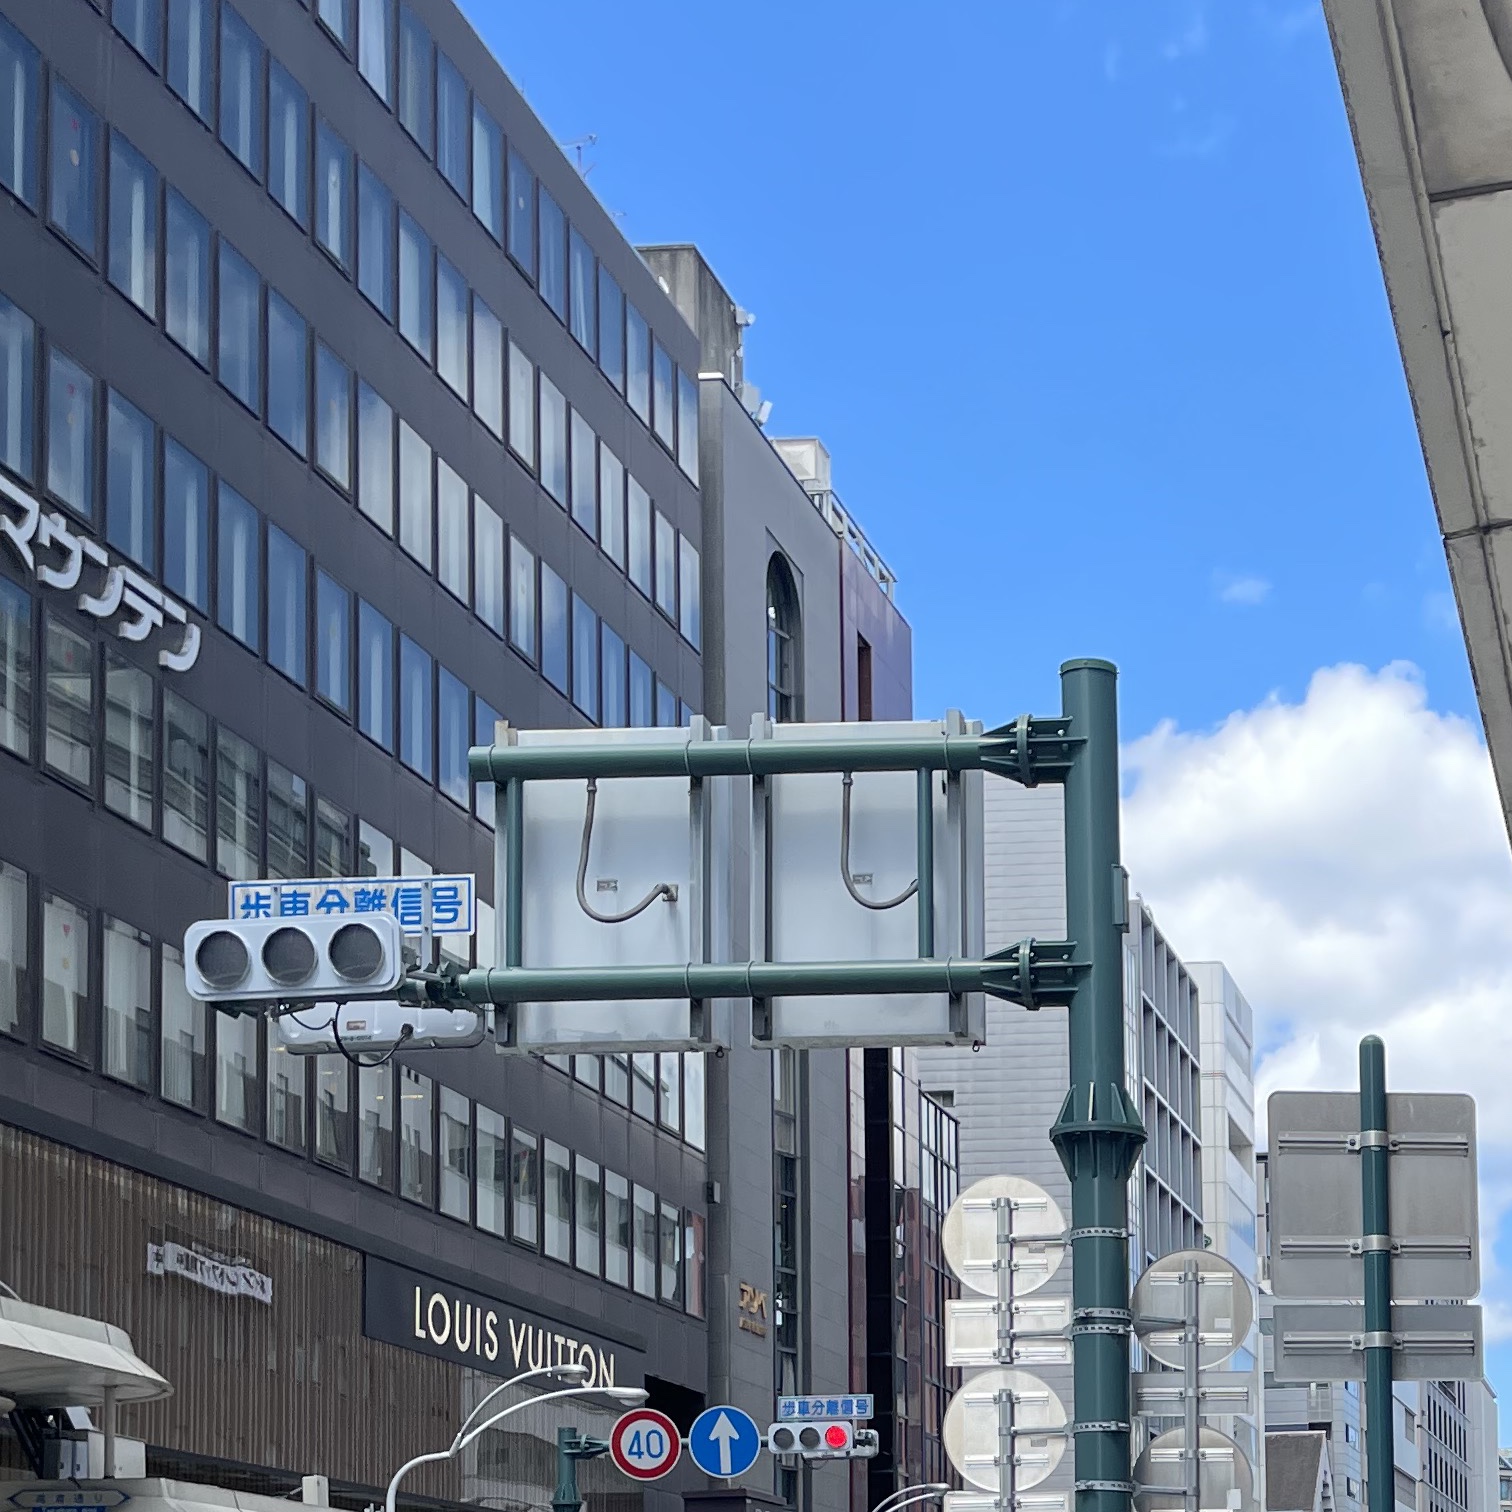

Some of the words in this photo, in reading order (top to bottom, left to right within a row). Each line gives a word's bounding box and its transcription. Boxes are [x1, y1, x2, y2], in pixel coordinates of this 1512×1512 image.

[240, 886, 463, 925] 歩車分離信号
[415, 1286, 499, 1361] LOUIS
[508, 1318, 615, 1388] VUITTON
[782, 1399, 868, 1416] 歩車分離信号
[628, 1429, 664, 1460] 40
